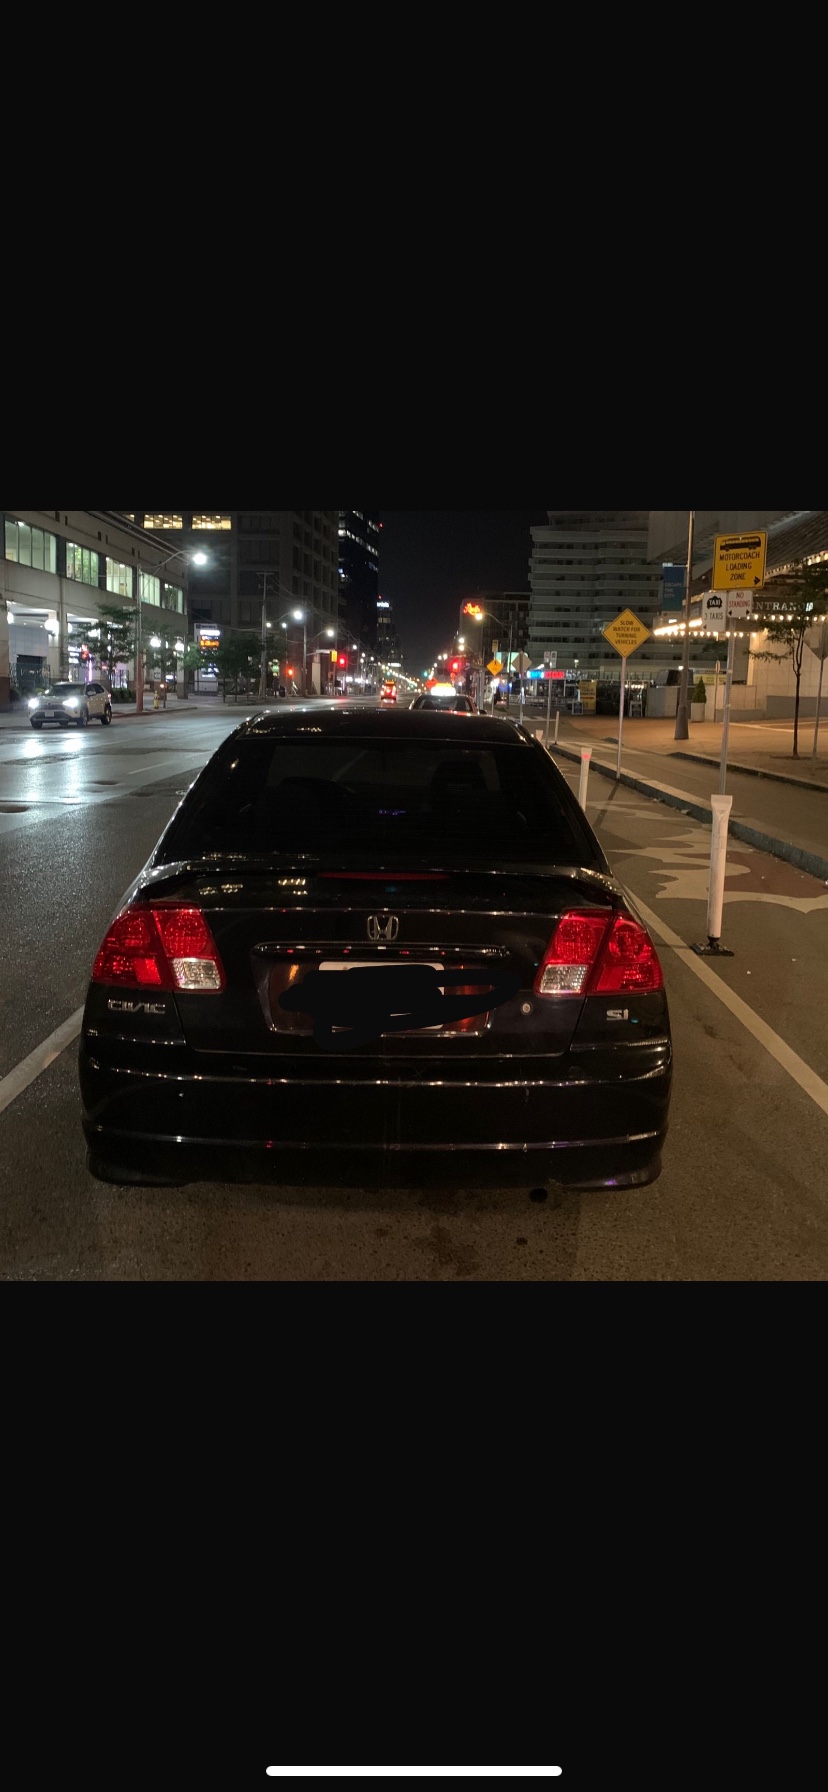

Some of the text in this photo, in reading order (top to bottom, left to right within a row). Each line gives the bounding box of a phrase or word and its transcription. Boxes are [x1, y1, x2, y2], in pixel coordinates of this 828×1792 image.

[719, 551, 760, 561] MOTORCOACH
[725, 562, 752, 571] LOADING
[730, 572, 746, 581] ZONE
[735, 591, 745, 599] NO
[729, 600, 751, 608] STANDING
[710, 612, 724, 620] TAXIS
[108, 999, 166, 1014] CIVIC
